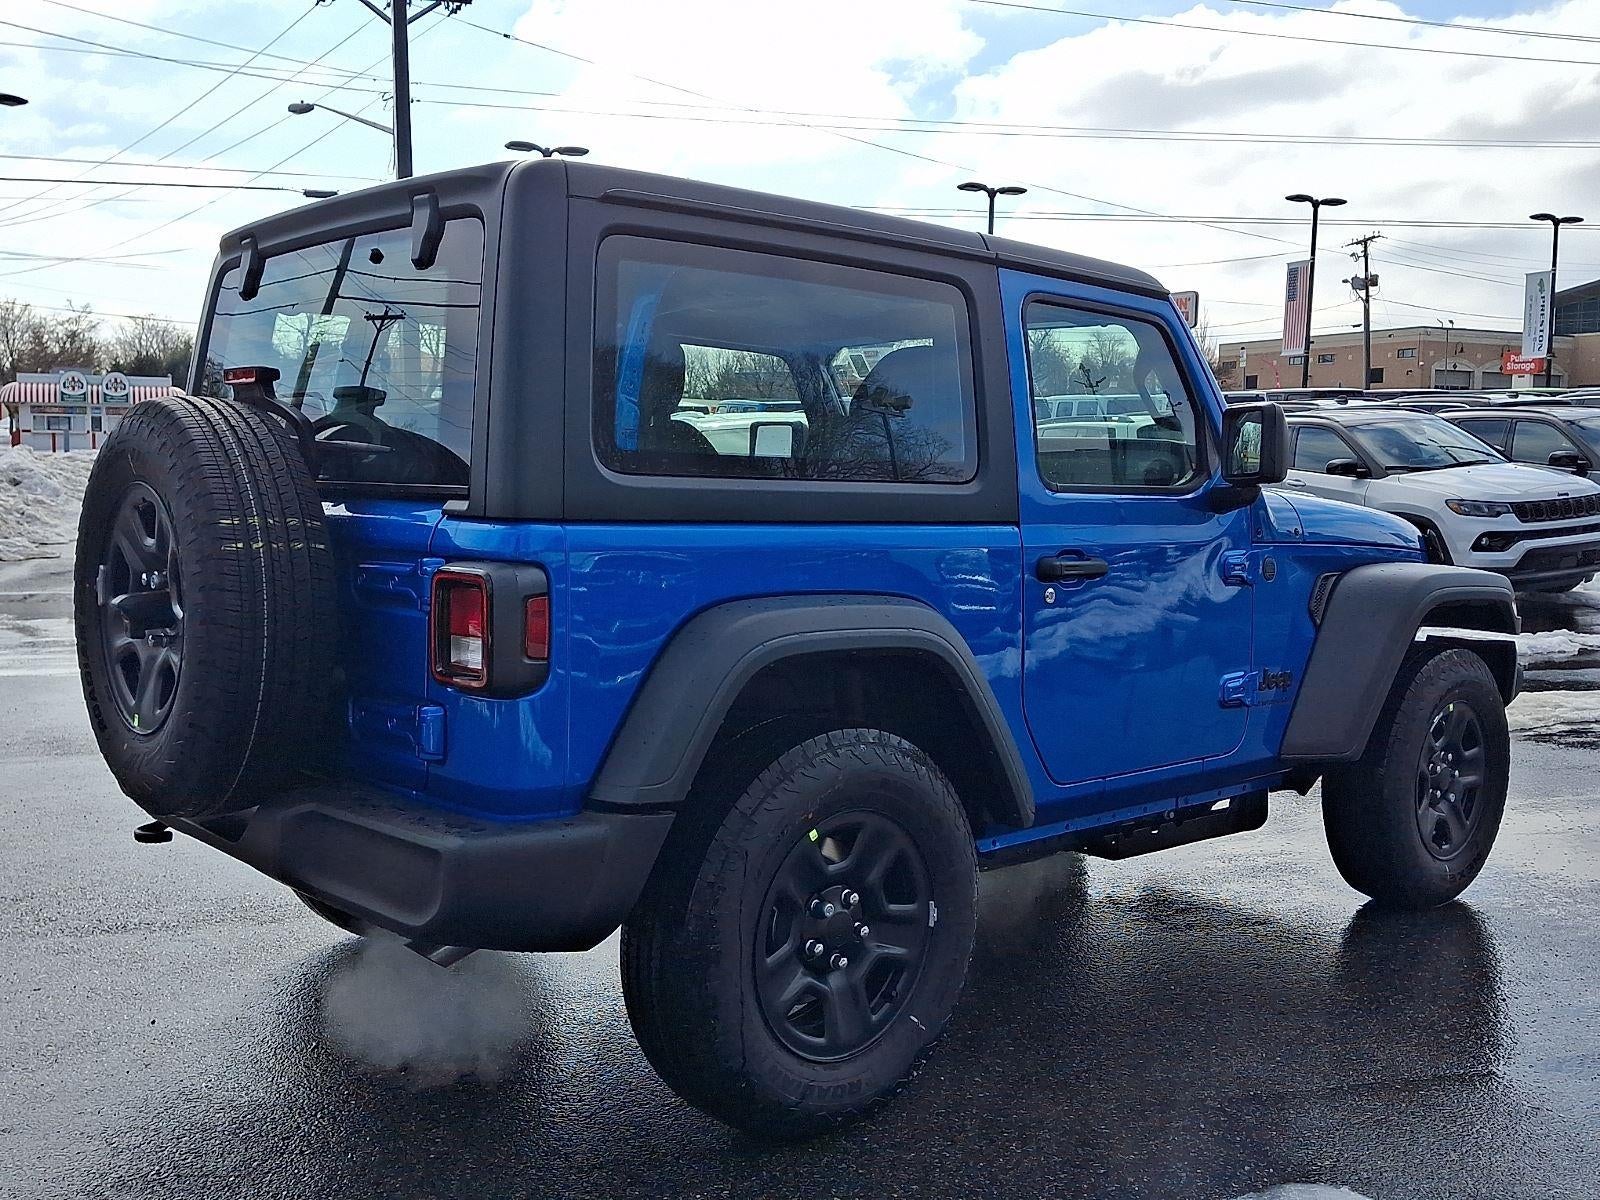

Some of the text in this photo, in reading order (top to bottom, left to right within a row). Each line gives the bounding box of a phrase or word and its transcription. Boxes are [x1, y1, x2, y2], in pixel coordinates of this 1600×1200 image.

[1537, 295, 1546, 352] PRESTON
[1506, 362, 1535, 372] Storage
[1258, 667, 1292, 692] Jeep
